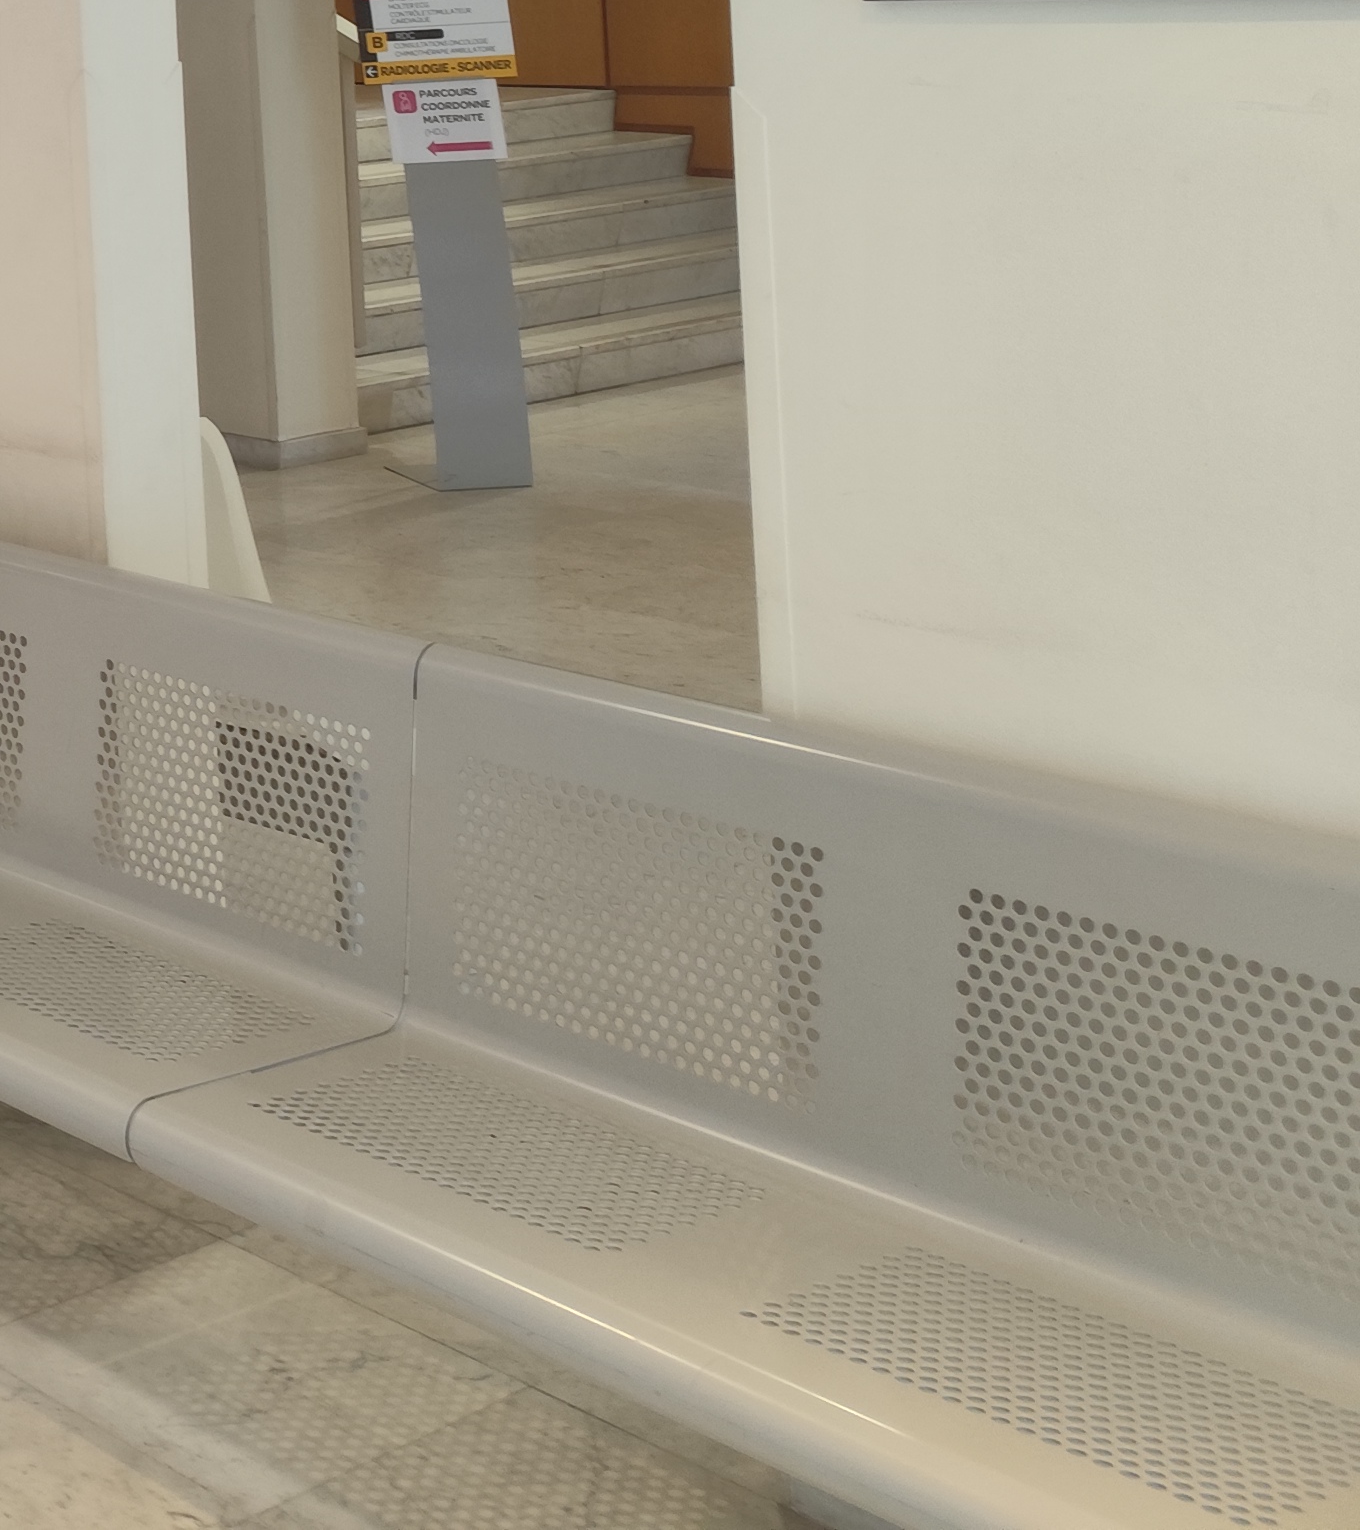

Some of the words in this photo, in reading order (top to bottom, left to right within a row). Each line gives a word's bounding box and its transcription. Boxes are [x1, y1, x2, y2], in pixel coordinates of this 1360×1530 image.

[395, 32, 415, 40] RDC
[372, 37, 384, 48] B
[381, 63, 449, 76] RADIOLOGIE
[457, 60, 512, 72] SCANNER
[419, 88, 477, 98] PARCOURS
[423, 113, 485, 124] MATERNITE
